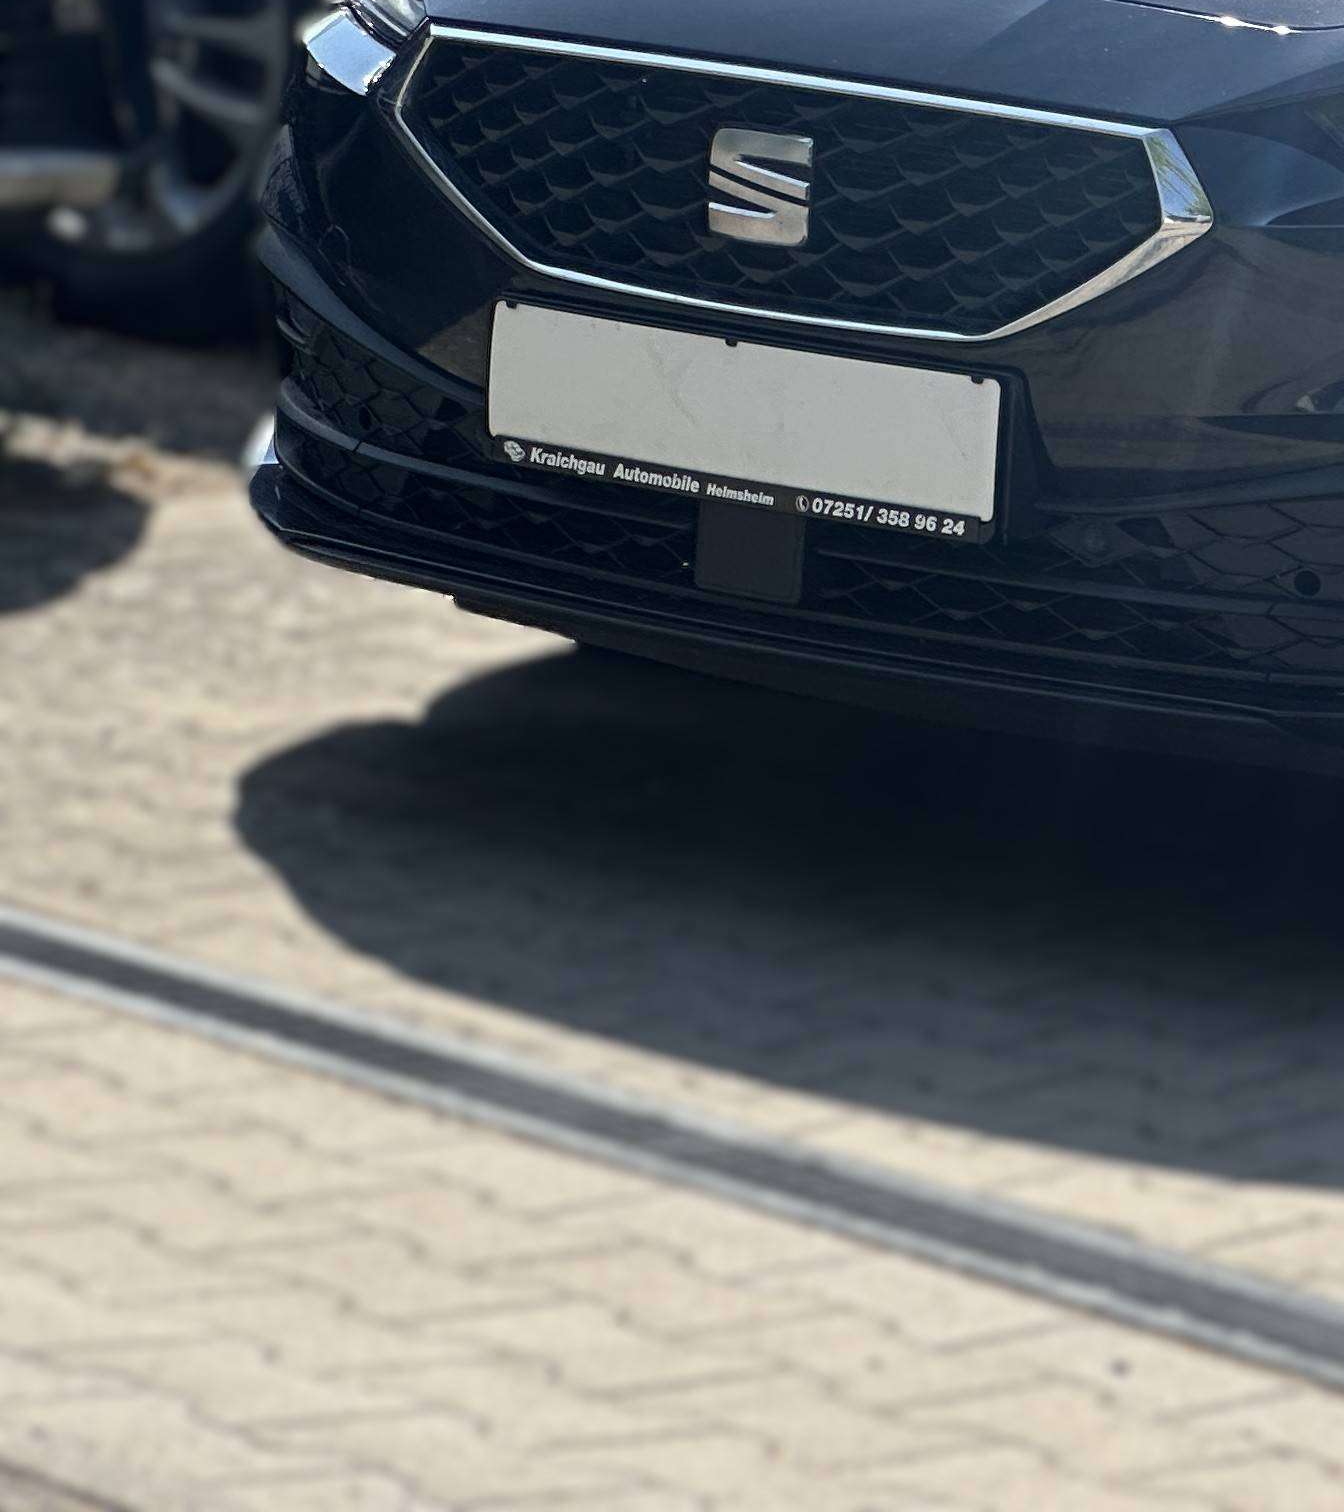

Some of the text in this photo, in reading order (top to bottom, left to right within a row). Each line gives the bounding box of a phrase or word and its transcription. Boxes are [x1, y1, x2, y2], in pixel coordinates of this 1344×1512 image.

[529, 446, 606, 476] Kraichgau
[612, 462, 701, 494] Automobile
[811, 496, 874, 523] 07251/
[876, 507, 910, 528] 358
[914, 514, 937, 533] 96
[941, 518, 966, 537] 24
